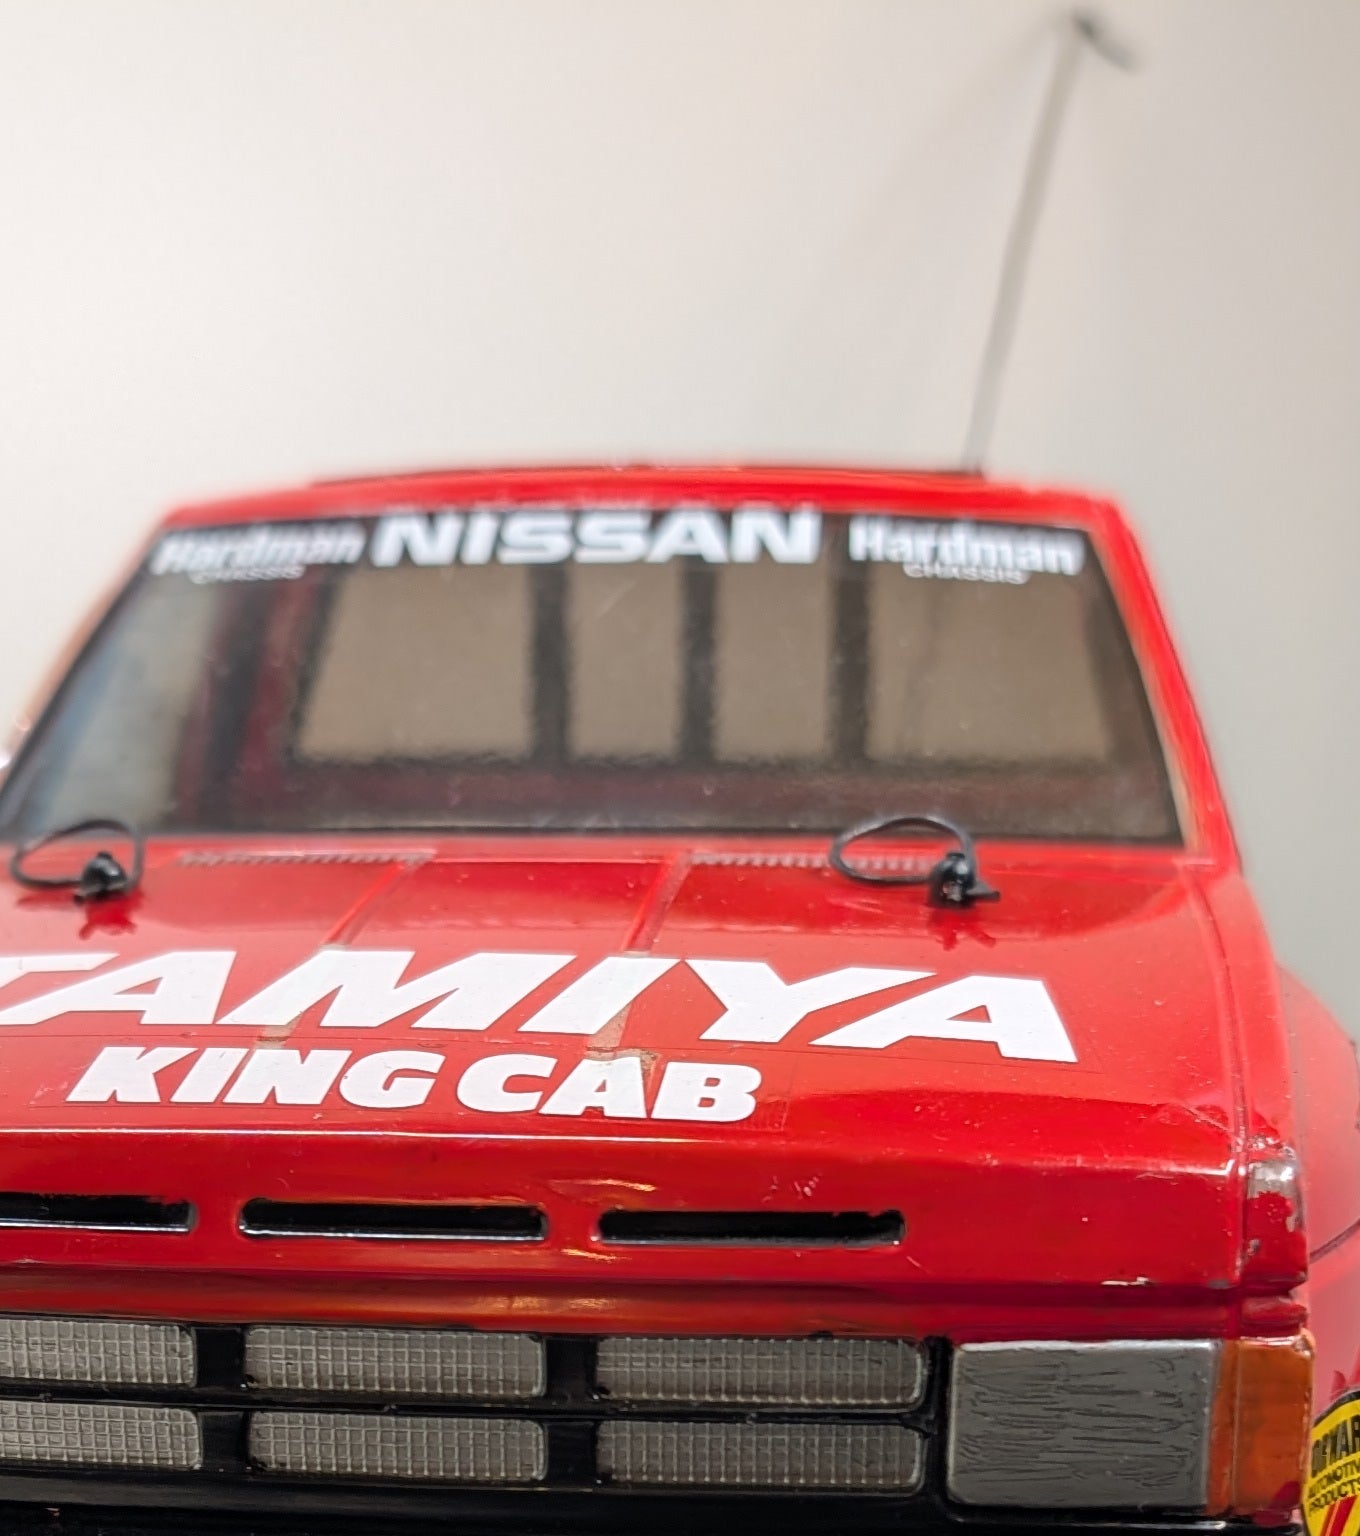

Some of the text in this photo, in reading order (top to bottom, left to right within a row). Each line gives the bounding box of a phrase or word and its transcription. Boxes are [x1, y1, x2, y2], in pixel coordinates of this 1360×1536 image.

[371, 510, 822, 565] NISSAN
[847, 518, 1084, 576] Hardman
[66, 1046, 763, 1123] KING CAB
